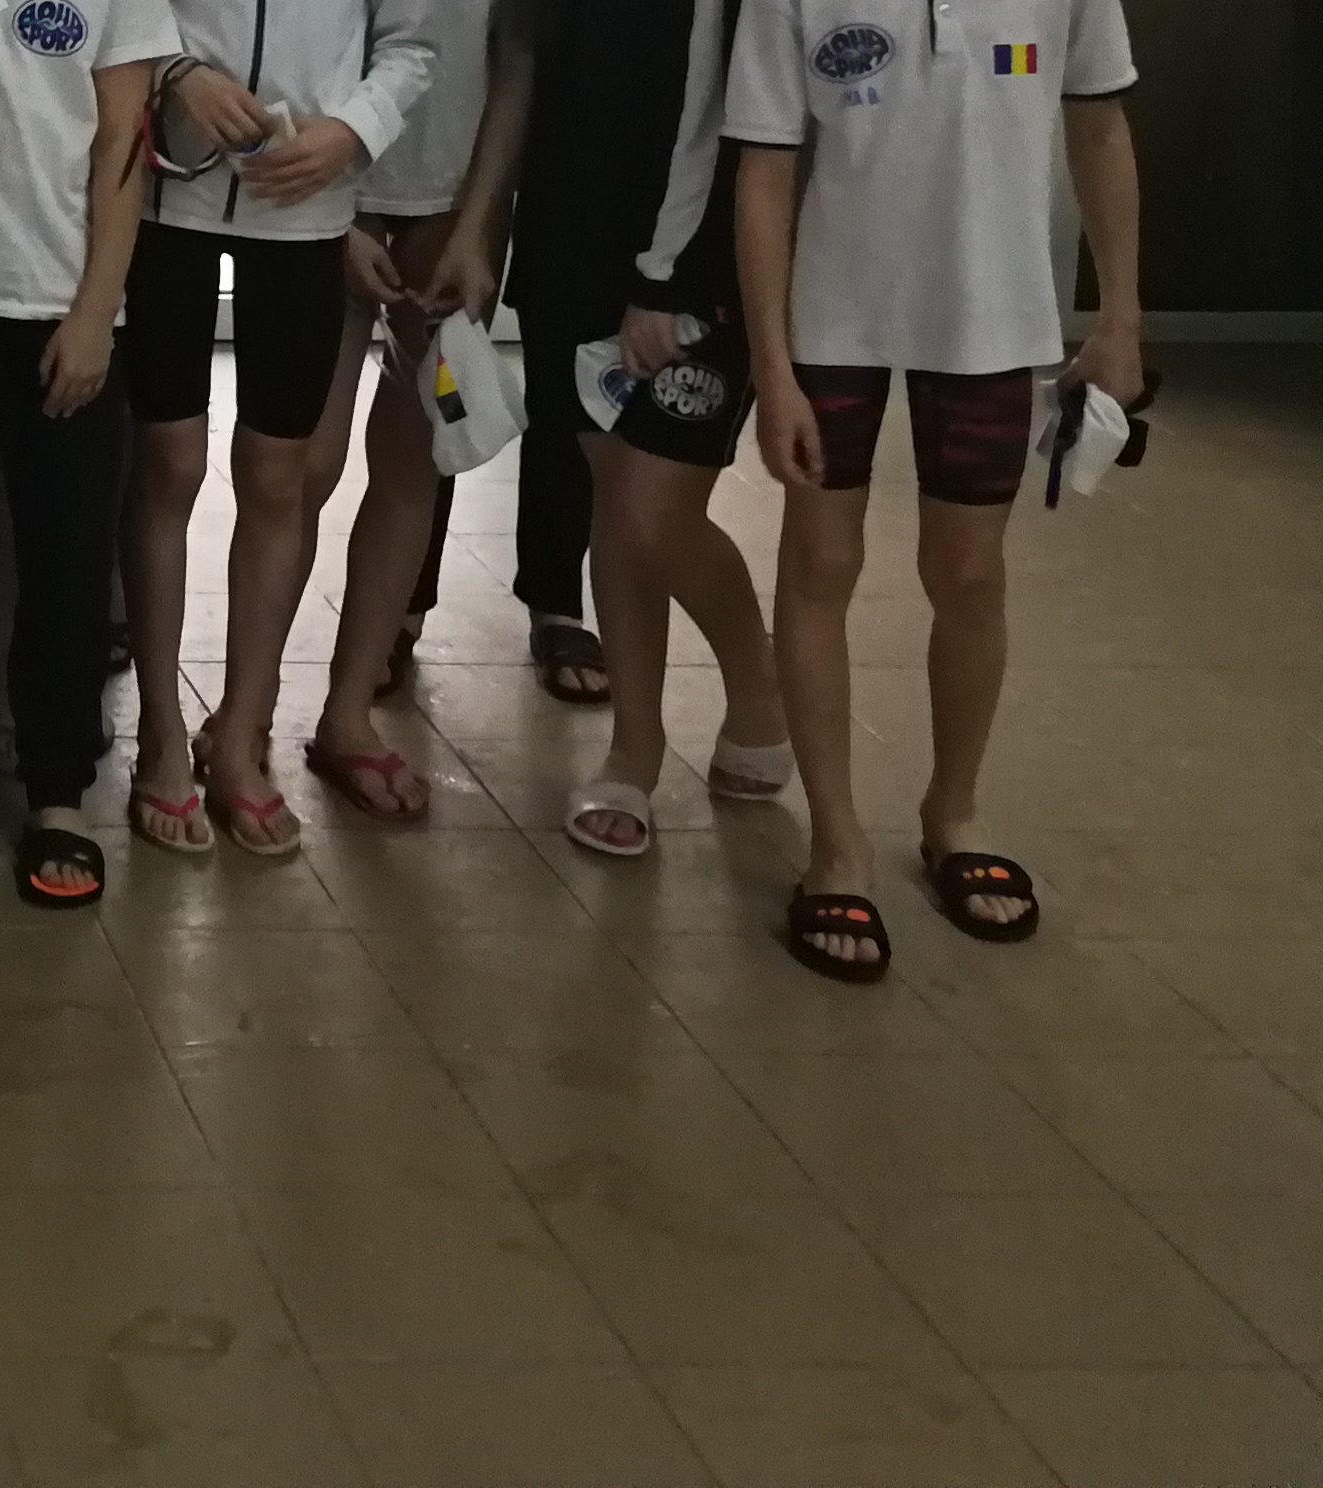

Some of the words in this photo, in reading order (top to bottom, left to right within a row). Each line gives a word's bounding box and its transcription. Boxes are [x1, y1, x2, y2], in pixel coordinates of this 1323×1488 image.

[17, 1, 83, 37] AQUA
[17, 26, 80, 51] SPORT
[815, 28, 889, 65] AQUA
[654, 366, 726, 396] AQUA
[654, 383, 723, 416] SPORT
